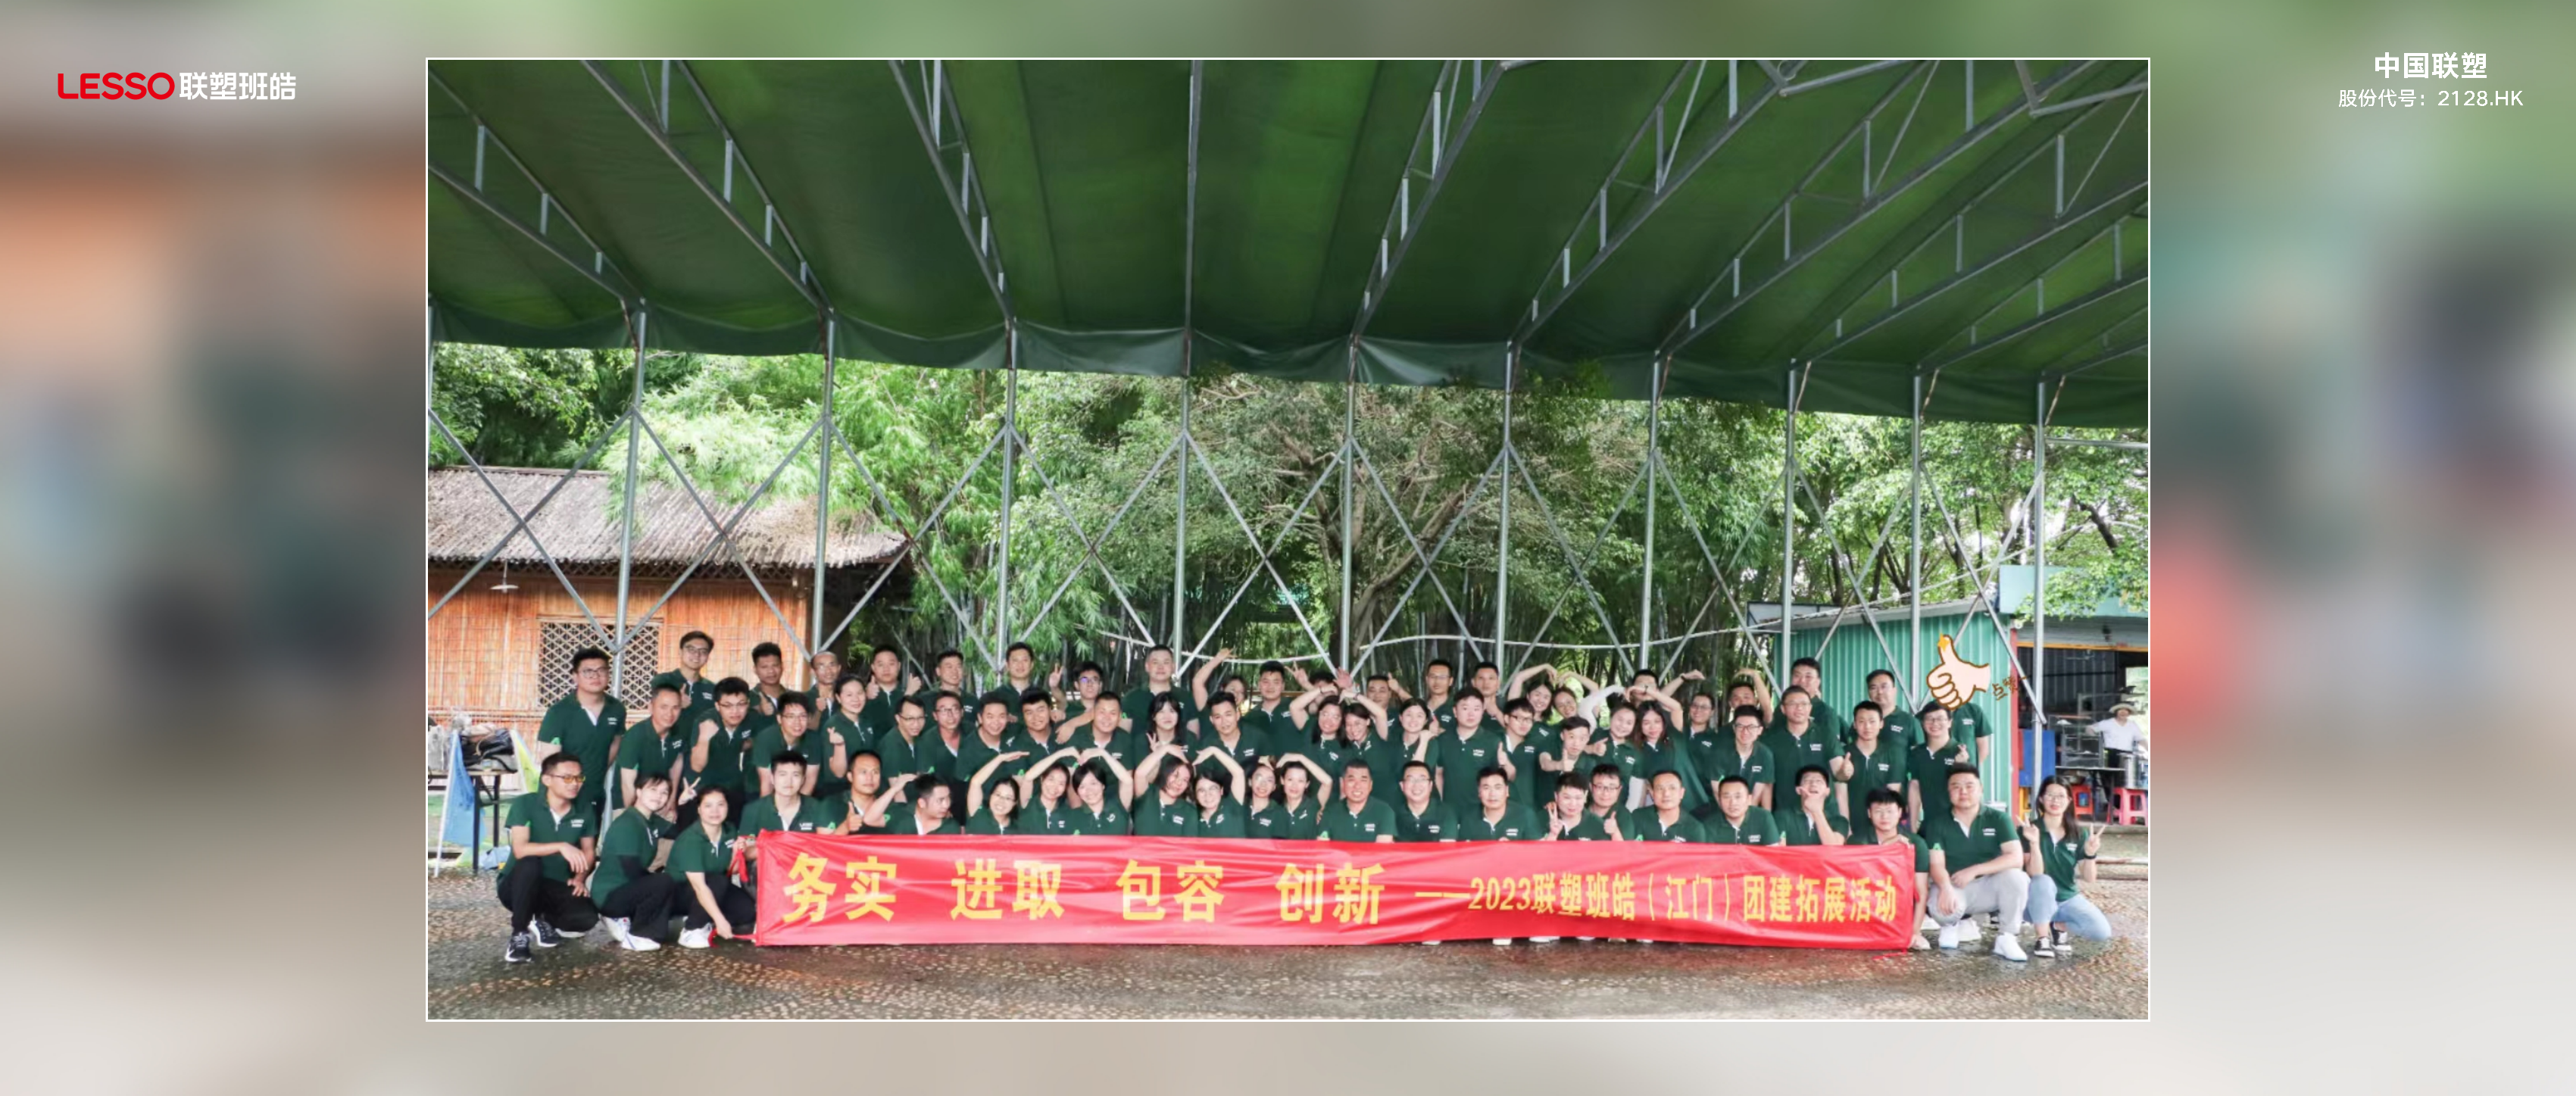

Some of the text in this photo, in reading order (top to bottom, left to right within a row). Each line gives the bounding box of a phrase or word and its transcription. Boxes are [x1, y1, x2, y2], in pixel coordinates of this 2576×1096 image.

[782, 853, 898, 923] 务实
[950, 857, 1065, 921] 进取
[1116, 859, 1225, 923] 包容
[1276, 862, 1385, 925] 创新
